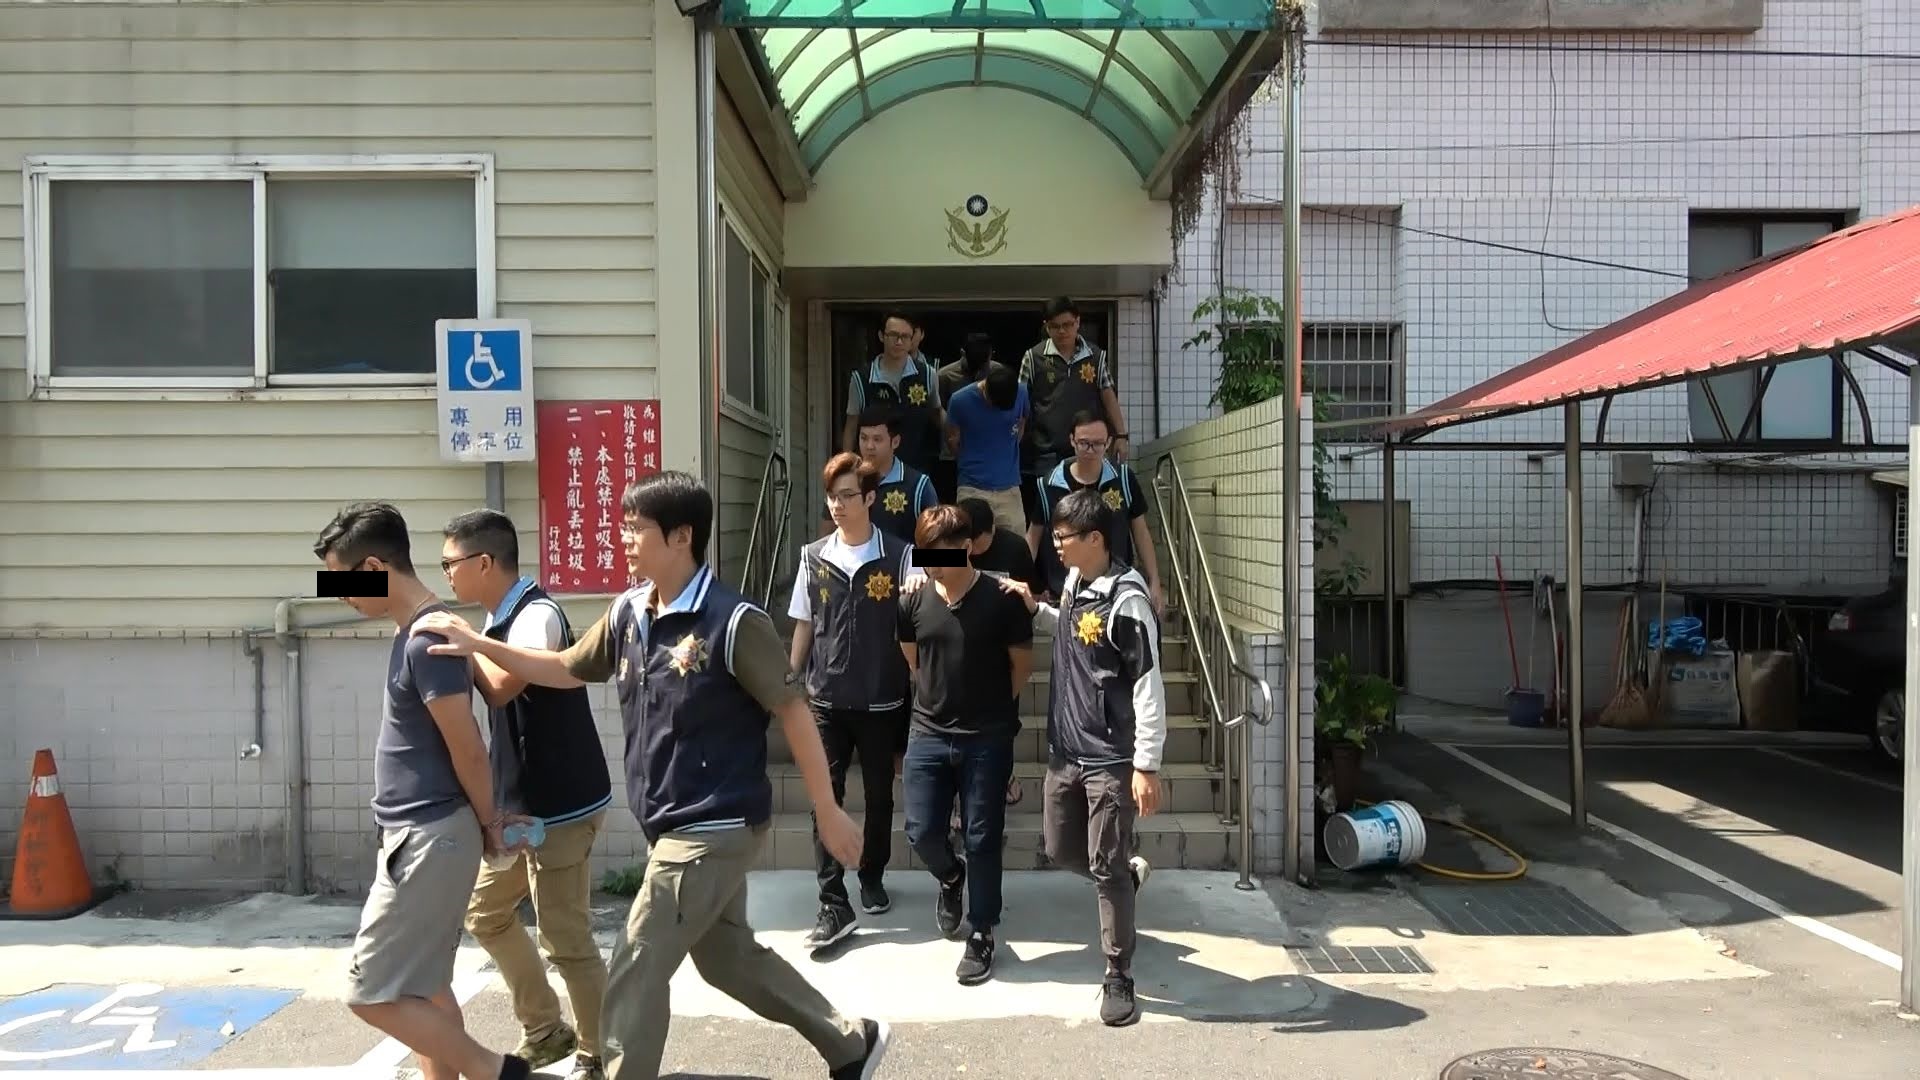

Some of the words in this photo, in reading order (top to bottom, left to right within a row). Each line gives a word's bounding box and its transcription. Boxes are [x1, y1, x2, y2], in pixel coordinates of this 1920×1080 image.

[566, 408, 586, 585] 二、禁止亂丟垃圾。
[623, 404, 638, 495] 敬請各位同
